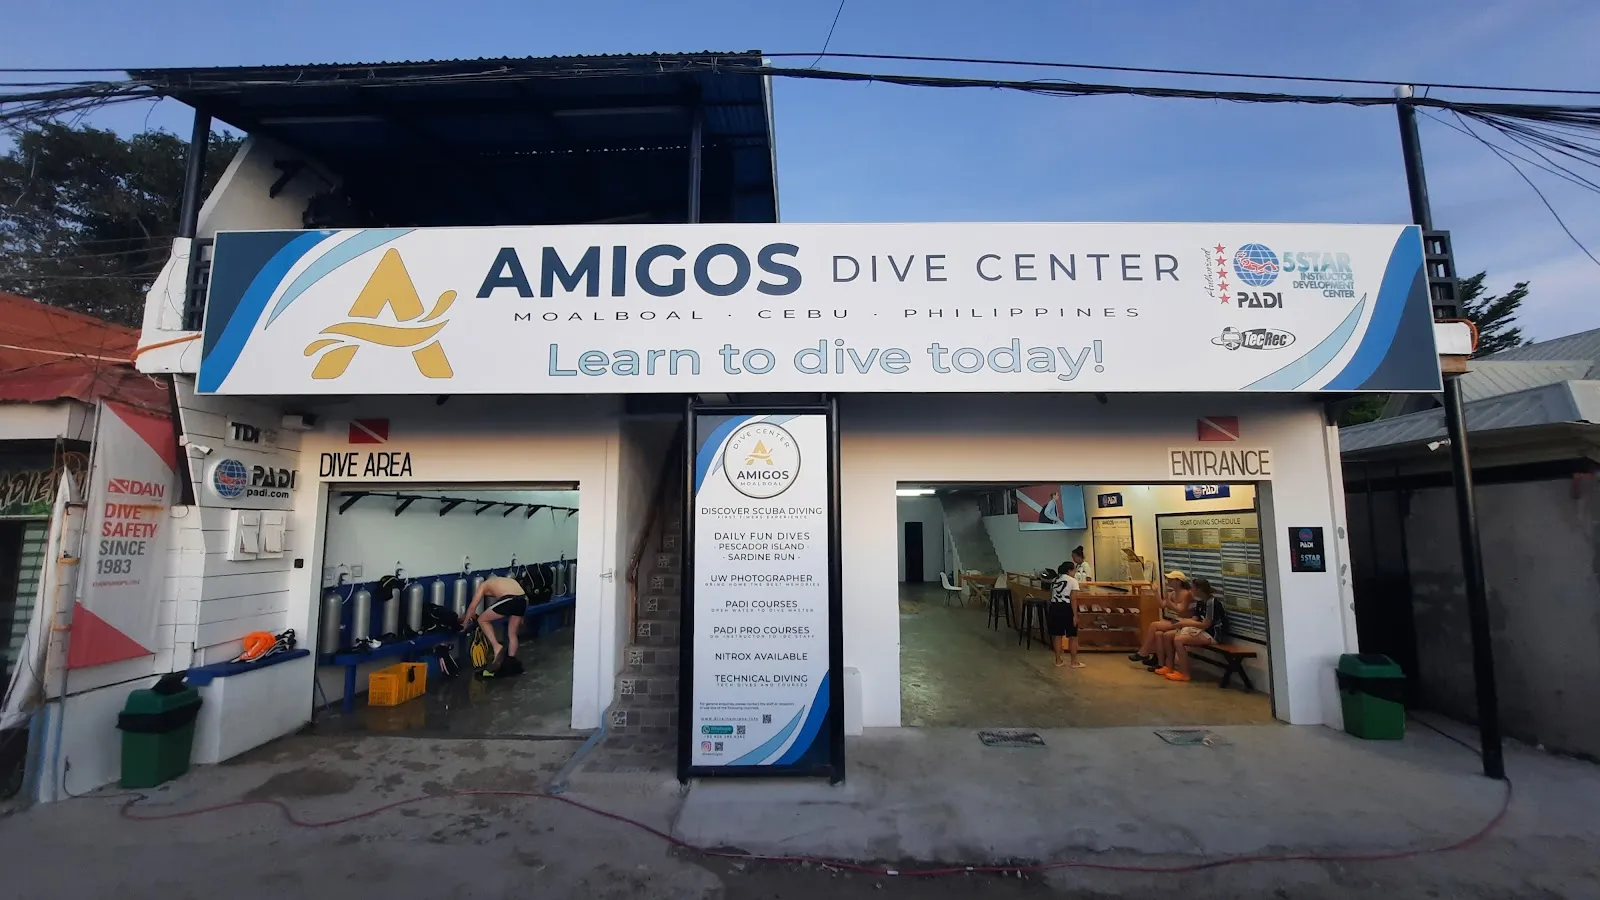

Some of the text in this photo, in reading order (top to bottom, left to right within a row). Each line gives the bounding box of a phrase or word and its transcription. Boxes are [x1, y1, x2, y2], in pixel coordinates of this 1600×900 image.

[475, 243, 1181, 298] AMIGOS DIVE CENTER
[1300, 272, 1354, 280] INSTRUCTOR
[1293, 281, 1354, 289] DEVELOPMENT
[1237, 292, 1283, 308] PADI
[1323, 289, 1355, 298] CENTER
[514, 307, 1140, 322] MOALBOAL CEBU PHILIPPINES
[1244, 331, 1288, 346] TecRec
[549, 338, 1105, 382] Learn to dive today!
[733, 428, 790, 450] DIVE CENTER
[319, 452, 413, 477] DIVE AREA
[1171, 450, 1271, 476] ENTRANCE
[252, 465, 297, 488] PADI
[736, 470, 789, 480] AMIGOS
[130, 483, 165, 497] DAN
[246, 488, 289, 499] padi.com
[104, 503, 142, 519] DIVE
[701, 507, 823, 515] DISCOVER SCUBA DIVING
[102, 522, 158, 538] SAFETY
[714, 532, 810, 540] DAILY FUN DIVES
[99, 540, 146, 556] SINCE
[96, 559, 132, 574] 1983
[725, 600, 798, 608] PADI COURSES
[713, 626, 810, 634] PADI PRO COURSES
[715, 652, 808, 660] NITROX AVAILABLE
[715, 674, 808, 682] TECHNICAL DIVING
